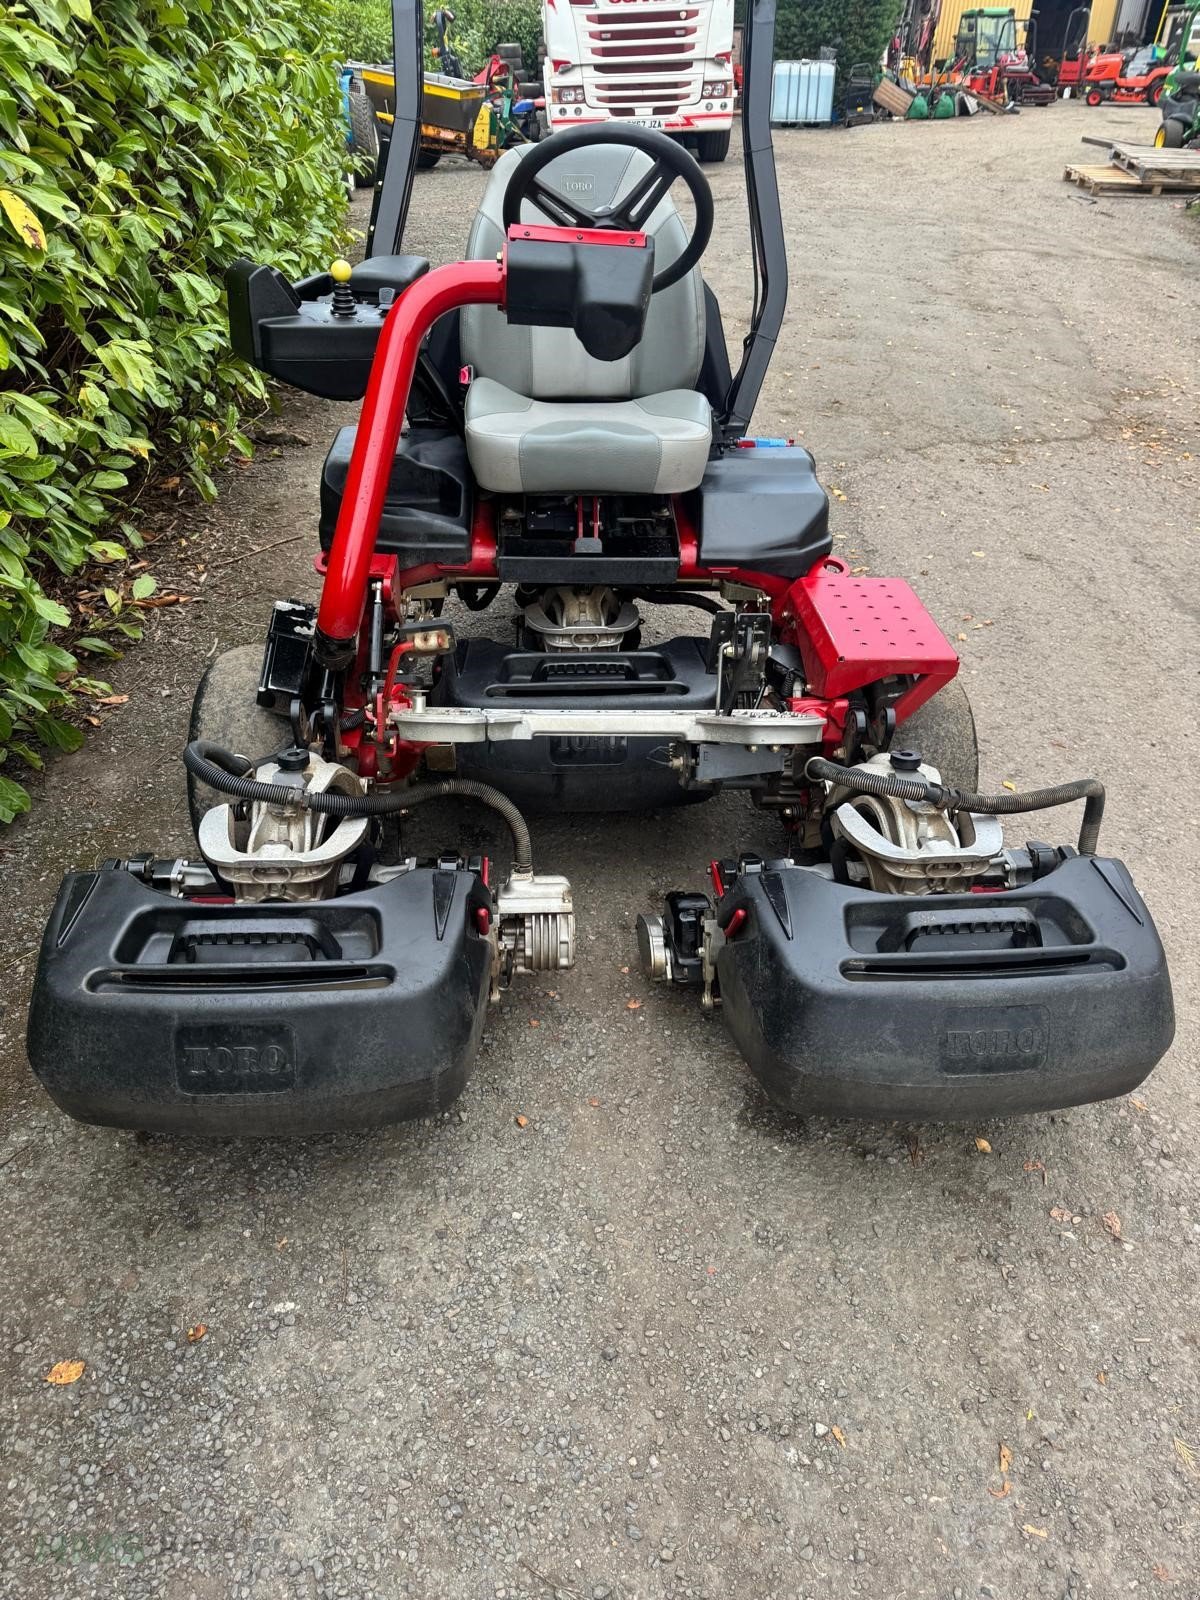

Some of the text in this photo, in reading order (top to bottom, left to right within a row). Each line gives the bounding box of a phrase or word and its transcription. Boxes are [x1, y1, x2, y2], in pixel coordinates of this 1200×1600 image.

[648, 120, 662, 128] JZA
[947, 1027, 1034, 1056] TORO
[183, 1045, 286, 1073] TORO
